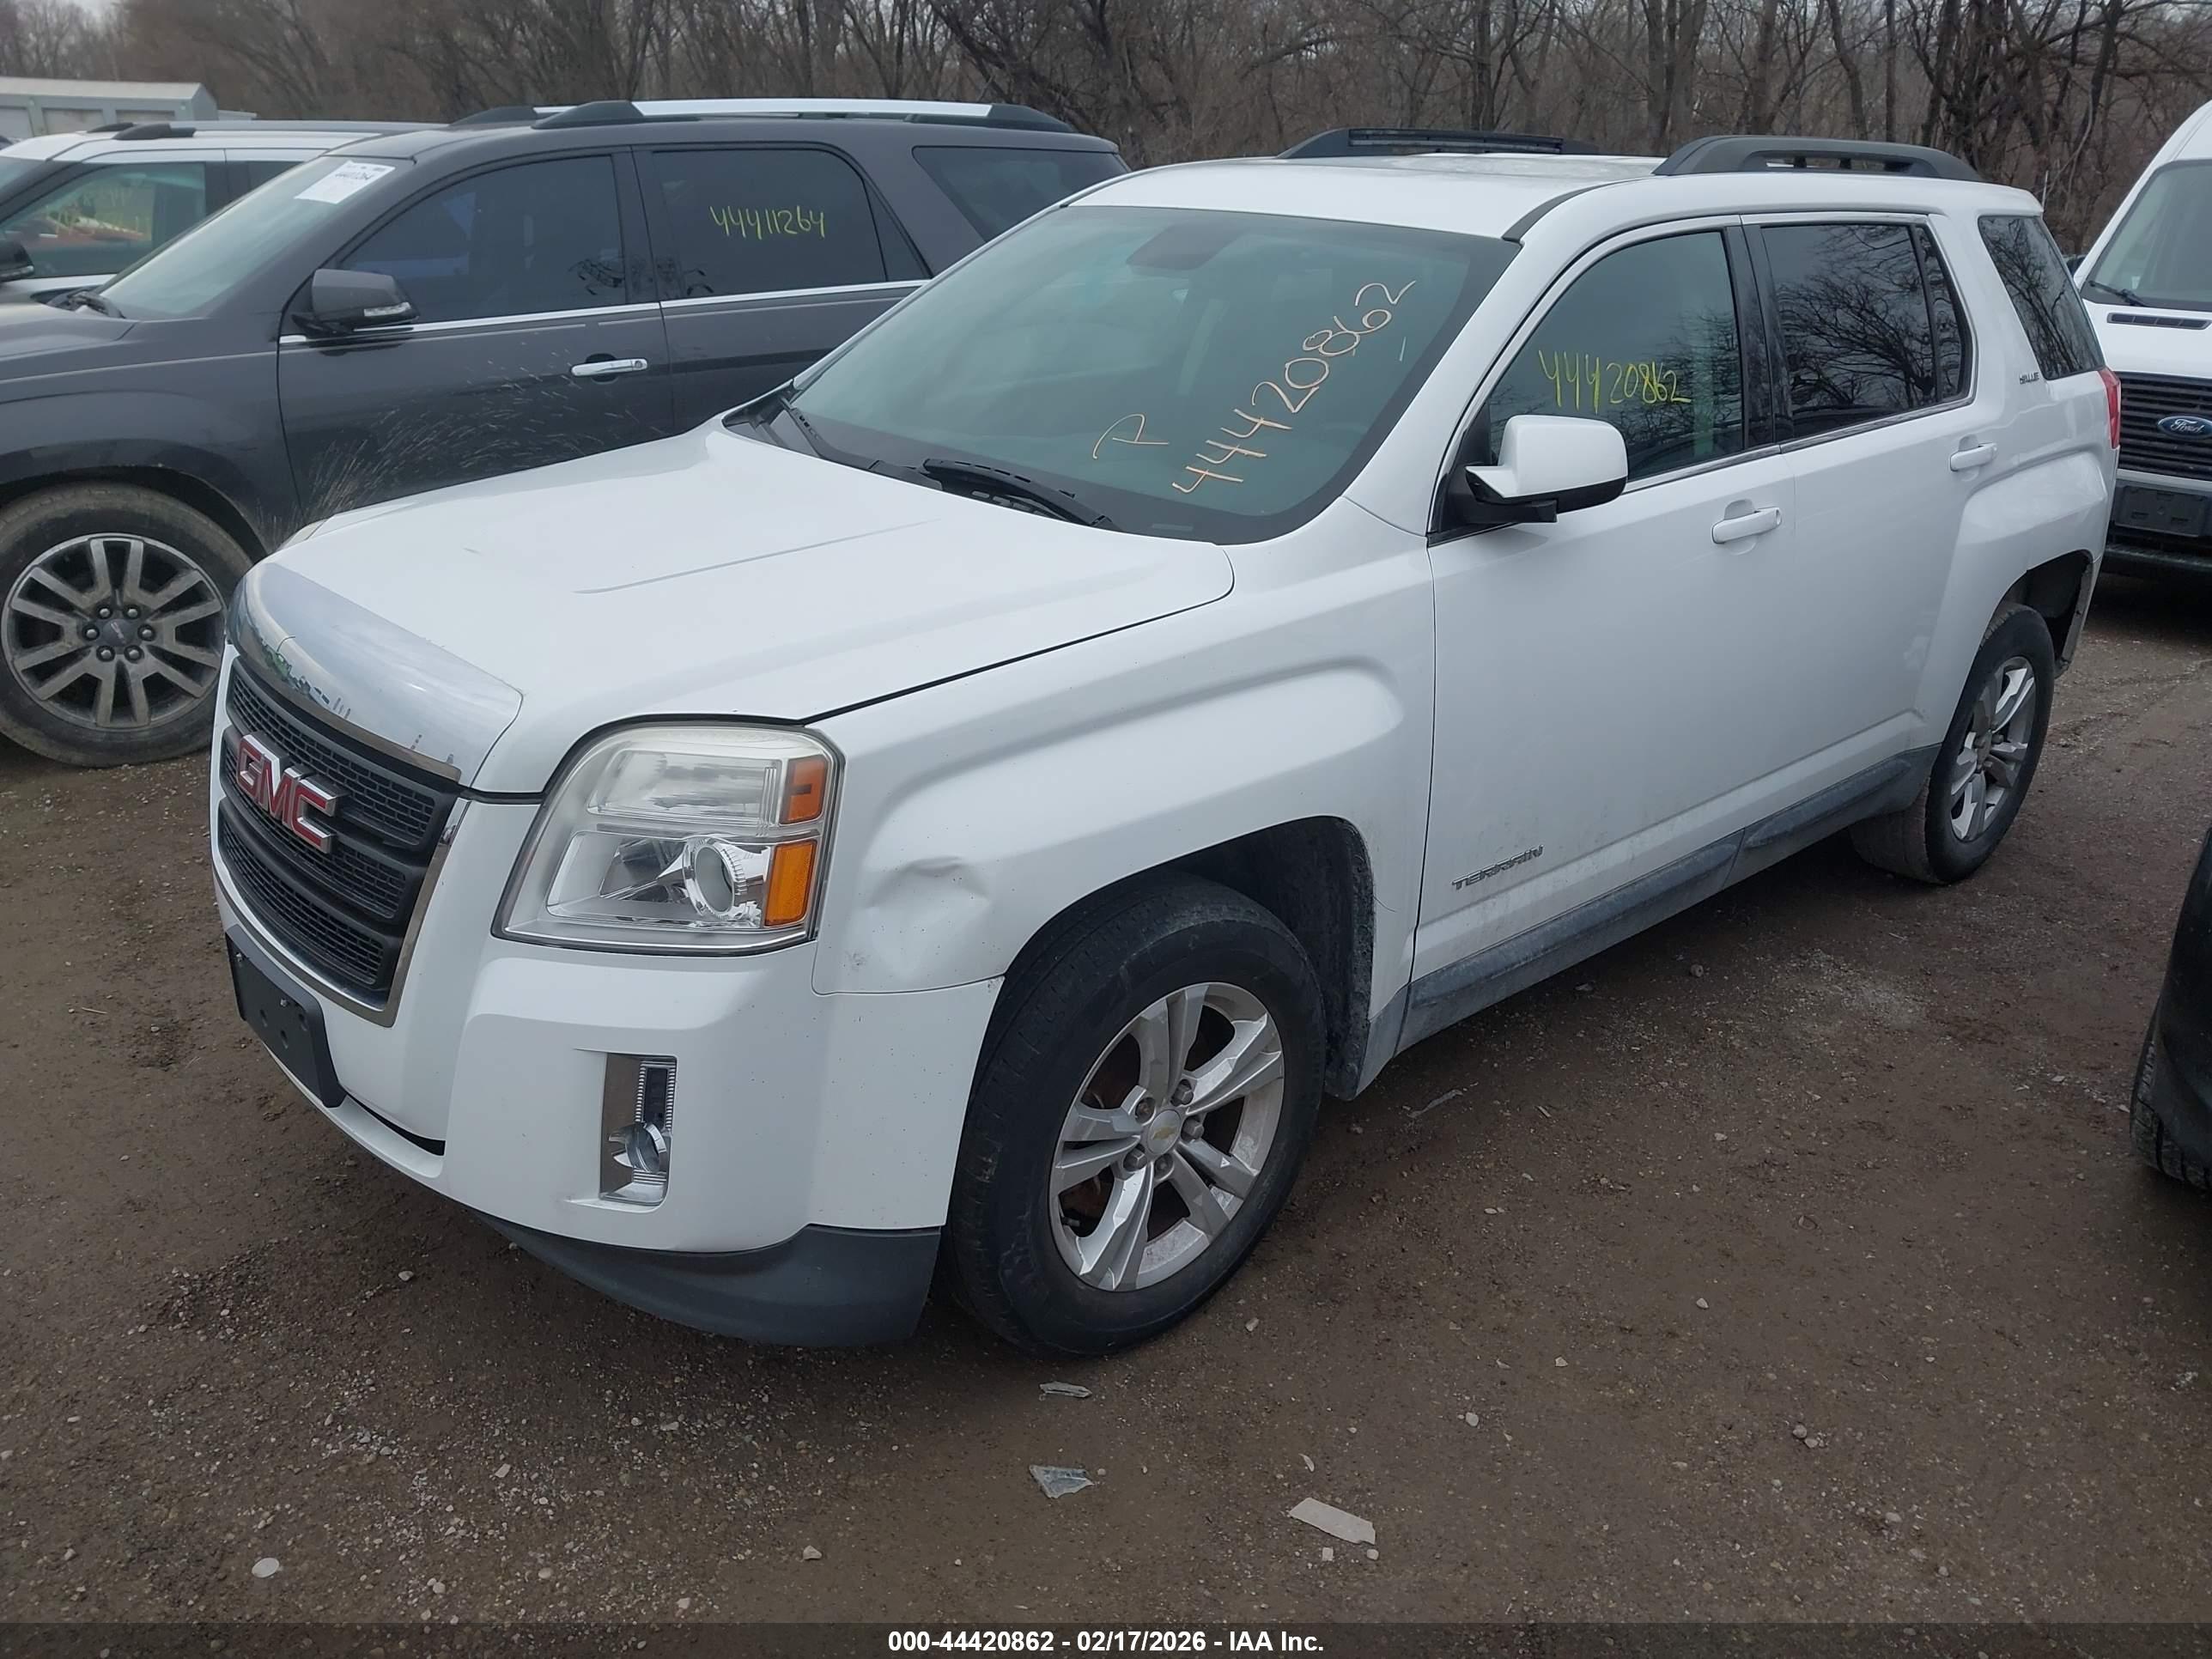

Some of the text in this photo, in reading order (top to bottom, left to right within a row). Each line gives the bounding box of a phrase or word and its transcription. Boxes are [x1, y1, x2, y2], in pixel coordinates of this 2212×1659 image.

[709, 205, 825, 240] 44411264
[1171, 280, 1417, 494] 44420862
[1538, 349, 1692, 416] 44420862
[236, 734, 337, 854] GMC
[1451, 844, 1544, 890] TERRAIN
